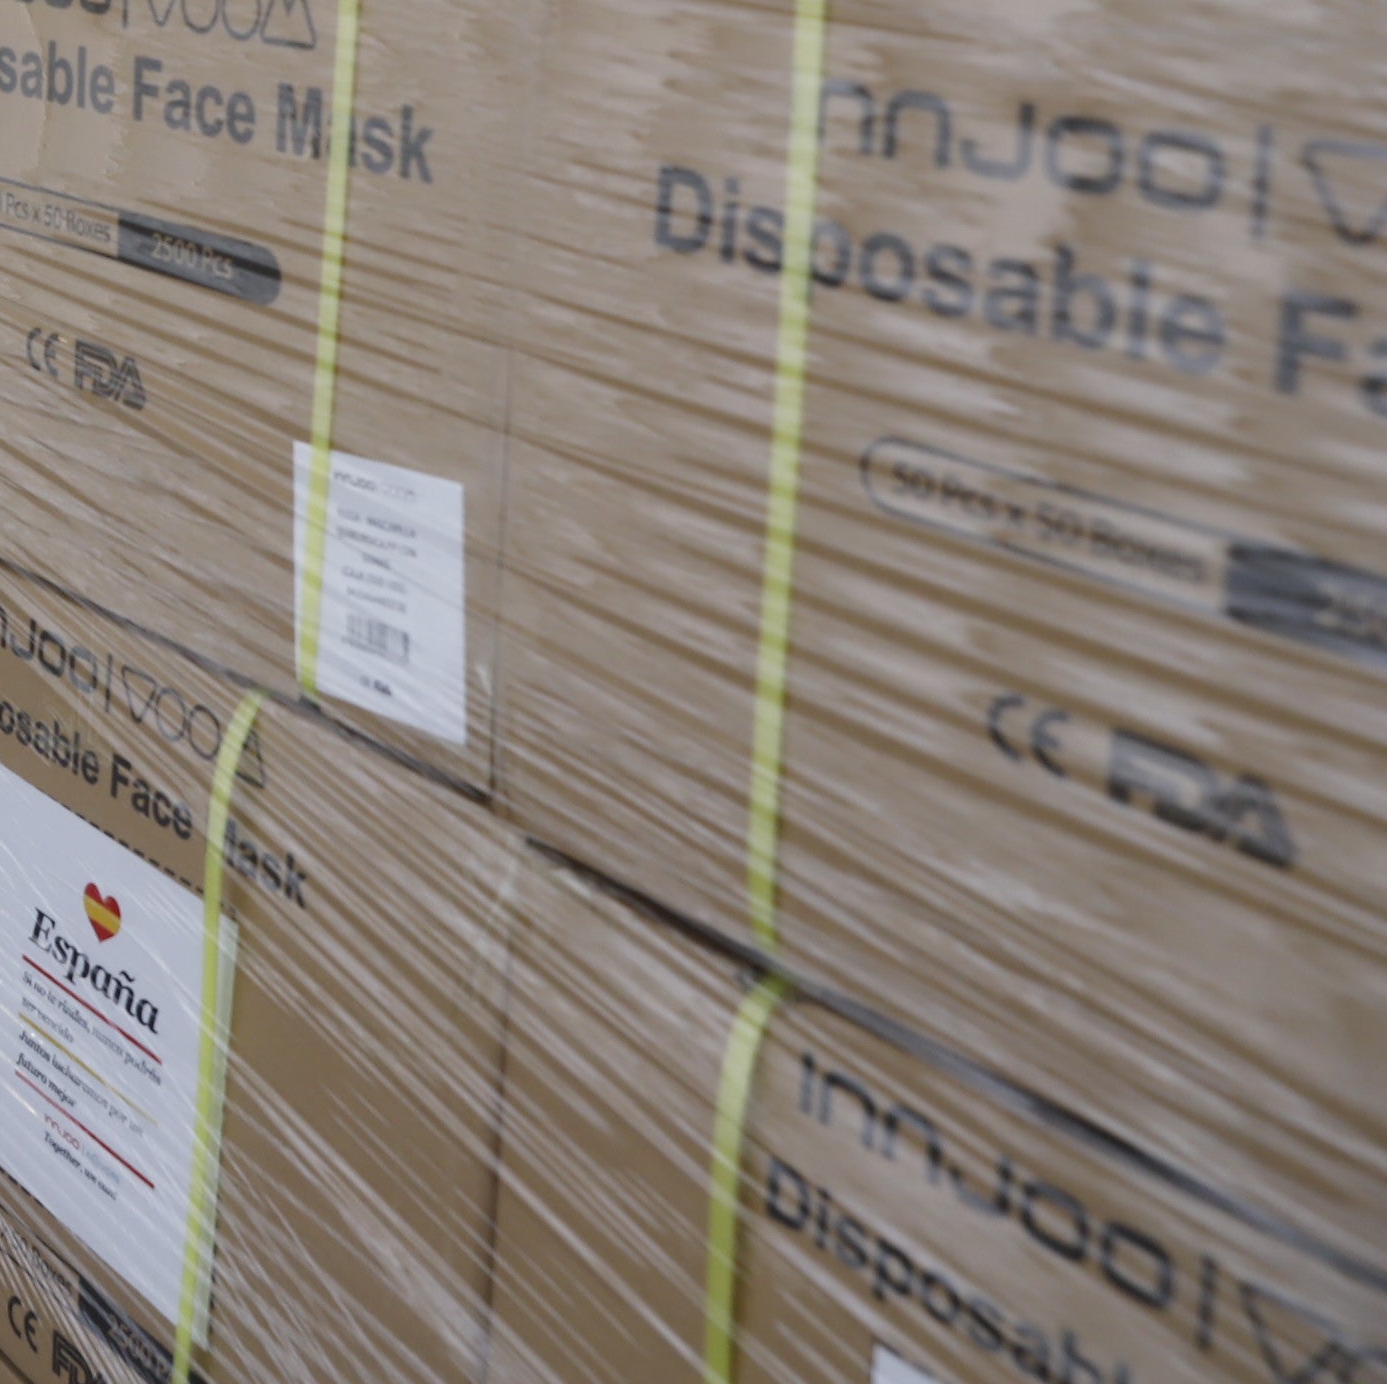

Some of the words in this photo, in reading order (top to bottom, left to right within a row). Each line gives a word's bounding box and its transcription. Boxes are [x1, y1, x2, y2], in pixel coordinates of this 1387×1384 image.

[132, 55, 256, 145] Face
[6, 194, 30, 220] Pcs
[43, 205, 62, 232] 50
[151, 232, 198, 268] 2500
[201, 245, 236, 281] Pcs
[74, 338, 147, 412] FDA
[110, 752, 193, 840] Face
[28, 907, 160, 1036] España
[52, 1329, 107, 1384] FD
